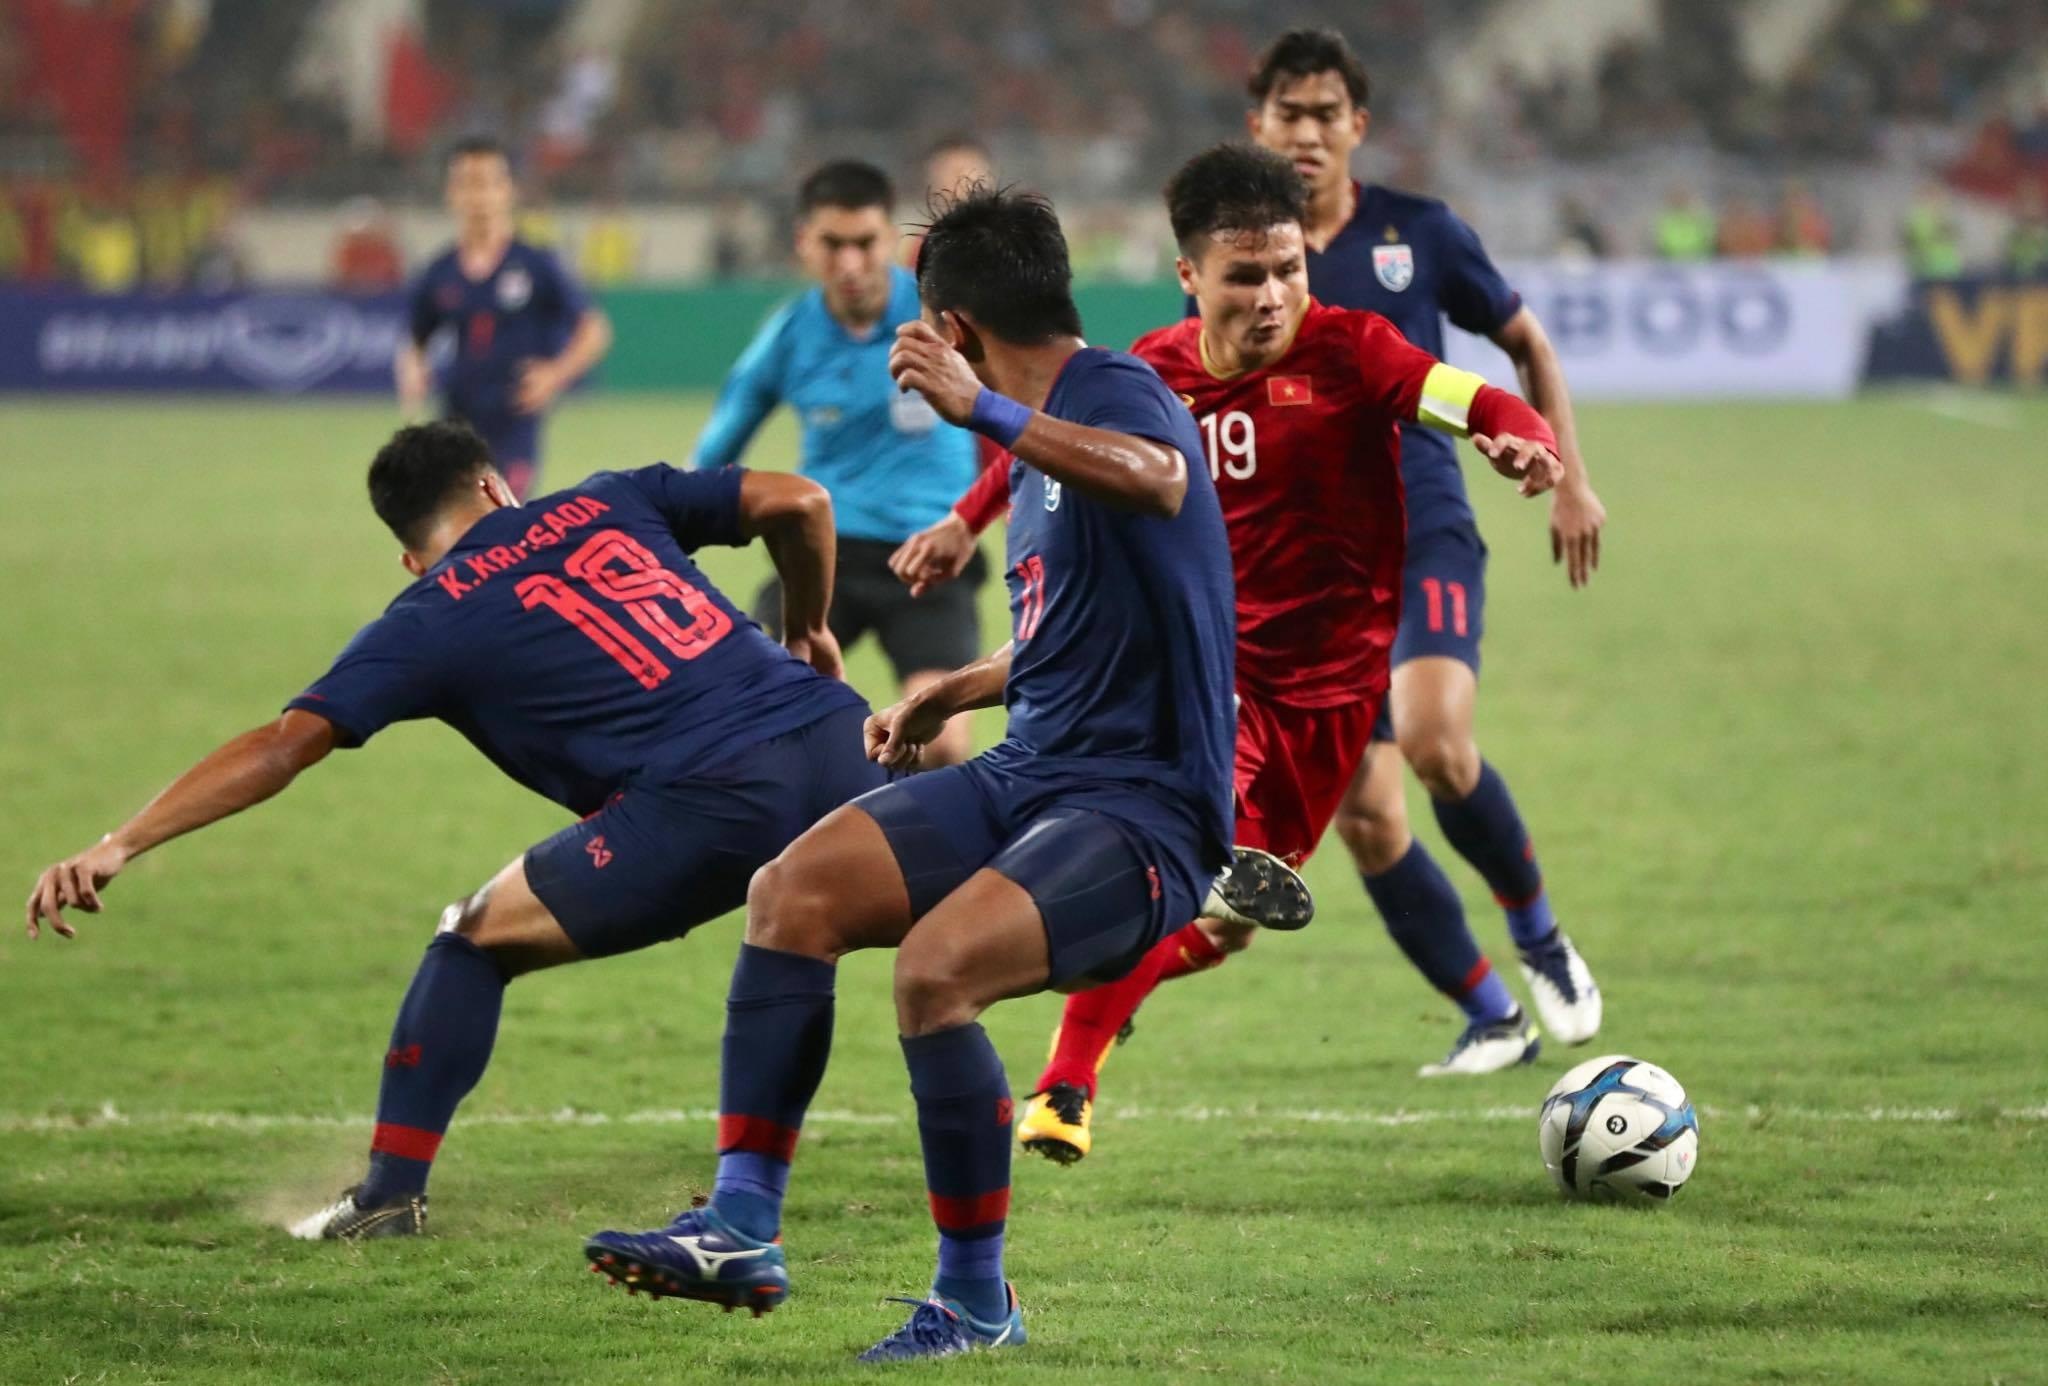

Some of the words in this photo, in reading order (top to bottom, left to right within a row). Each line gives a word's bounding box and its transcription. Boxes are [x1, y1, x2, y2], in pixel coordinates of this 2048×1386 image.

[1200, 410, 1257, 481] 19
[513, 529, 733, 690] 18
[1421, 577, 1468, 638] 11
